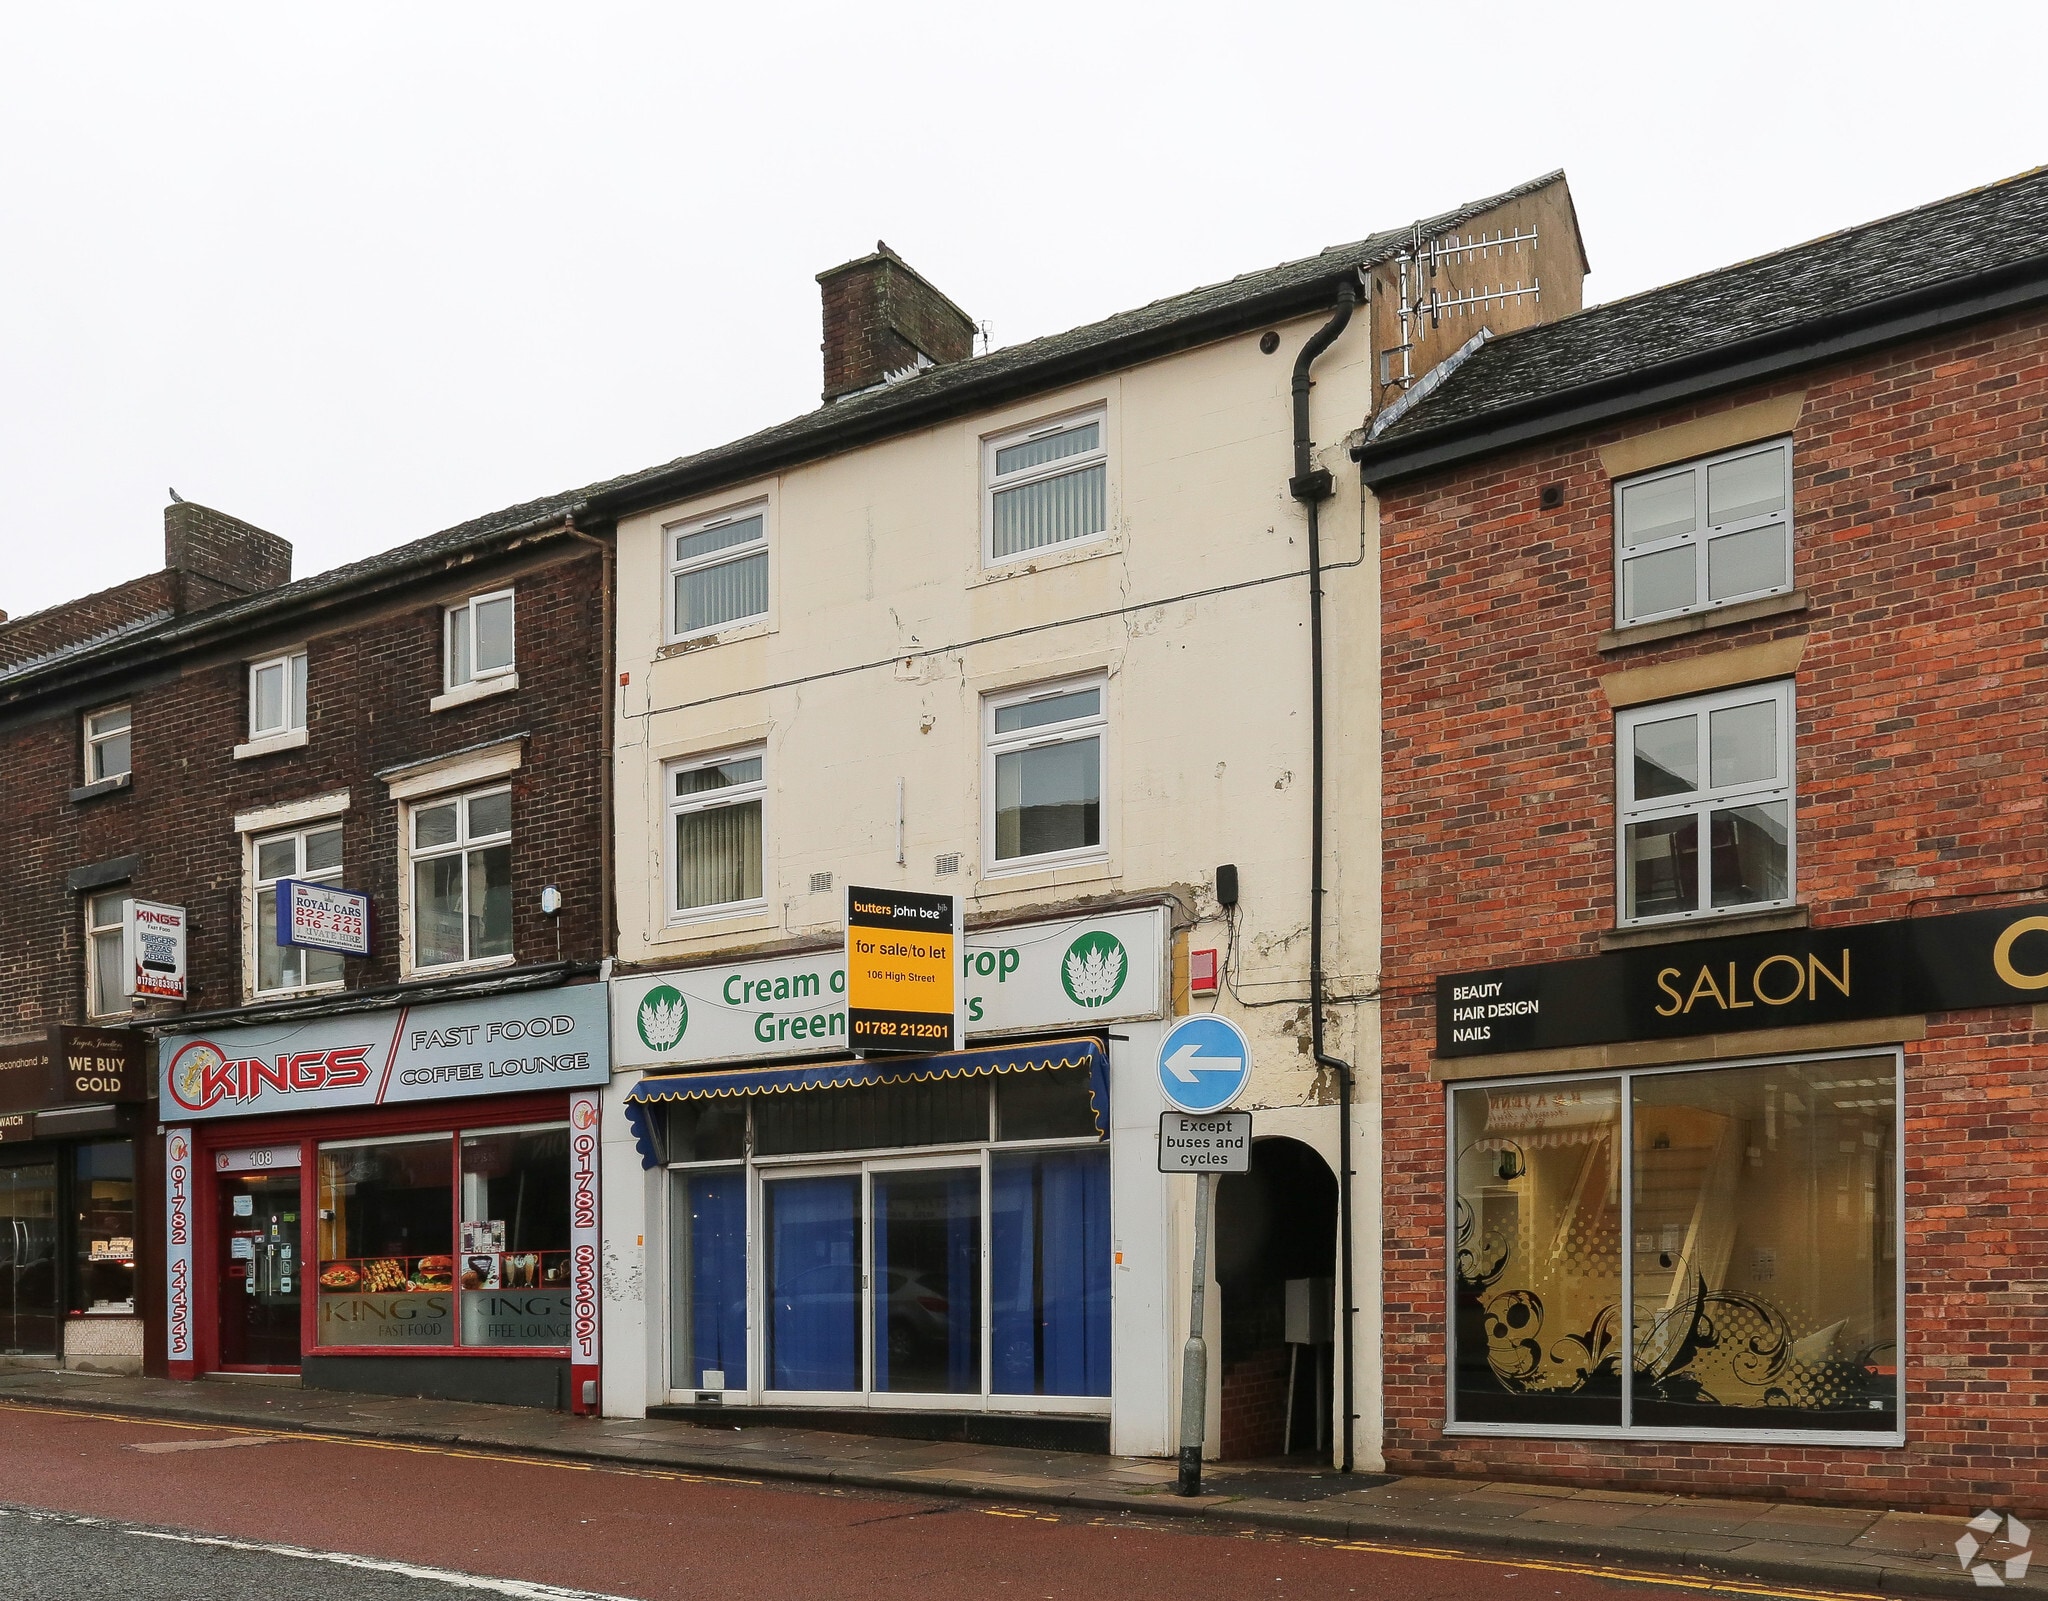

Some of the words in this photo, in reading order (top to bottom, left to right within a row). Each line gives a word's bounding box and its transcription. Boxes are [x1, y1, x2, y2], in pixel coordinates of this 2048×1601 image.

[296, 897, 331, 912] ROYAL
[334, 904, 361, 917] CARS
[854, 901, 891, 915] butters
[892, 905, 917, 918] john
[919, 906, 940, 919] bee
[136, 909, 182, 927] KINGS
[296, 907, 362, 926] 822-225
[296, 917, 362, 936] 816-444
[140, 932, 177, 947] BURGERS
[340, 933, 361, 944] HIRE
[144, 950, 175, 963] KEBABS
[145, 943, 172, 955] PIZZAS
[856, 939, 875, 954] for
[879, 943, 926, 958] sale/to
[929, 945, 946, 959] let
[137, 975, 156, 987] 01782
[158, 979, 182, 991] 833091
[723, 972, 820, 1005] Cream
[830, 970, 845, 993] o
[964, 948, 1020, 982] rop
[867, 970, 883, 979] 106
[885, 971, 906, 983] High
[908, 972, 936, 983] Street
[1654, 947, 1851, 1017] SALON
[1453, 982, 1503, 1001] BEAUTY
[1453, 1005, 1486, 1022] HAIR
[1488, 999, 1539, 1018] DESIGN
[411, 1025, 480, 1050] FAST
[486, 1015, 575, 1044] FOOD
[754, 1012, 845, 1042] Green
[855, 1020, 897, 1035] 01782
[900, 1023, 948, 1038] 212201
[1453, 1026, 1491, 1042] NAILS
[40, 1055, 49, 1065] Je
[68, 1056, 92, 1071] WE
[96, 1057, 126, 1072] BUY
[400, 1063, 483, 1086] COFFEE
[489, 1052, 590, 1078] LOUNGE
[200, 1043, 375, 1106] KINGS
[75, 1077, 121, 1092] GOLD
[1179, 1118, 1233, 1134] Except
[1166, 1136, 1210, 1149] buses
[1216, 1135, 1244, 1149] and
[250, 1151, 273, 1166] 108
[1180, 1151, 1228, 1167] cycles
[574, 1135, 595, 1228] 01782
[171, 1165, 187, 1245] 01782
[171, 1259, 188, 1353] 444543
[575, 1245, 596, 1356] 833091
[378, 1324, 406, 1337] FAST
[409, 1322, 442, 1336] FOOD
